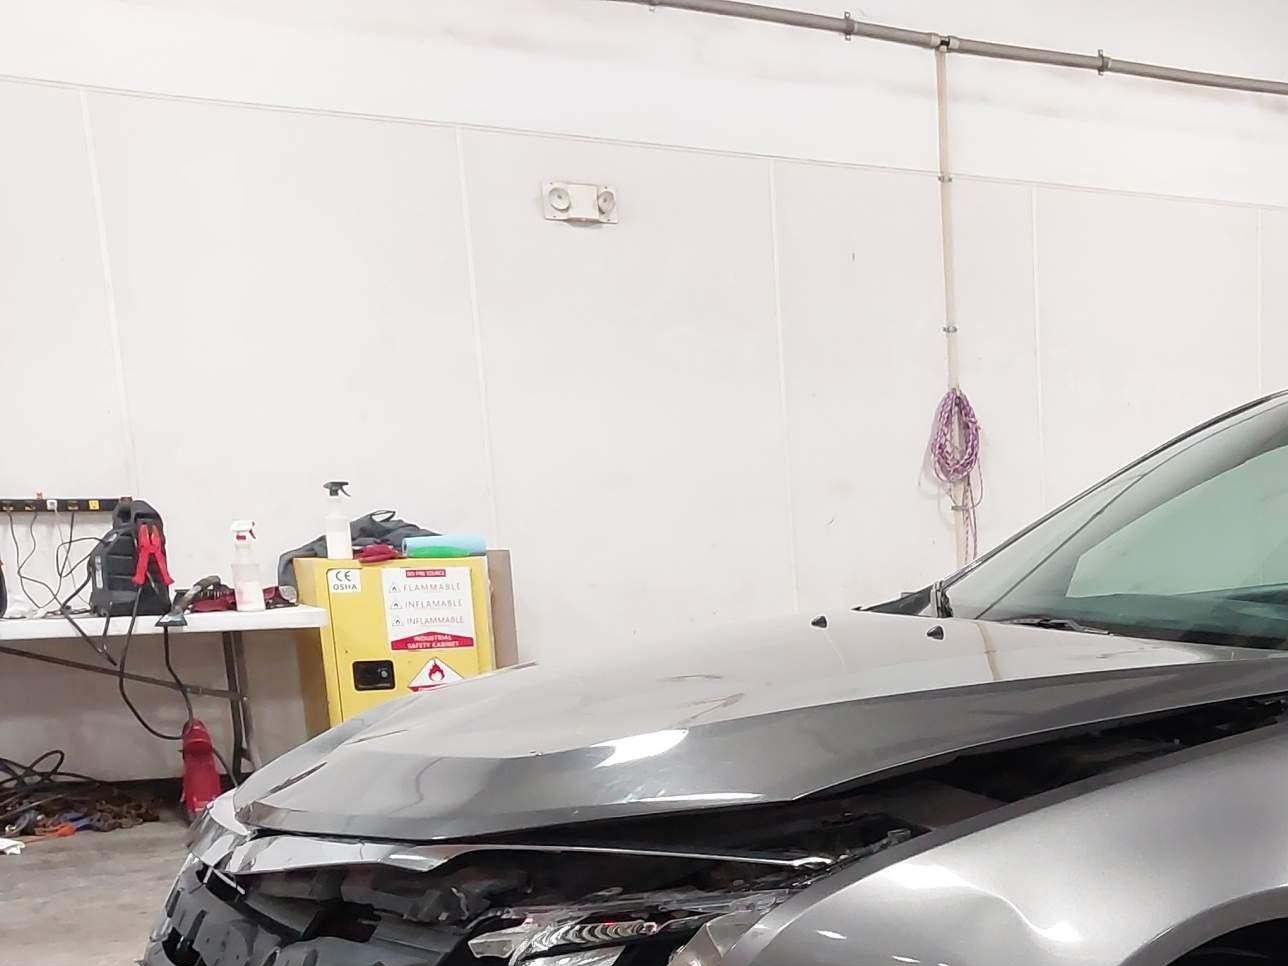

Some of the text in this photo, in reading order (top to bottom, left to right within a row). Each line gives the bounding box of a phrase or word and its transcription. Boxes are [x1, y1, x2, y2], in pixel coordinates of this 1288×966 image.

[333, 583, 358, 591] OSHA
[403, 582, 461, 592] FLAMMABLE
[405, 599, 463, 609] INFLAMABLE
[406, 615, 464, 625] INFLAMMABLE
[407, 641, 431, 649] SAFETY
